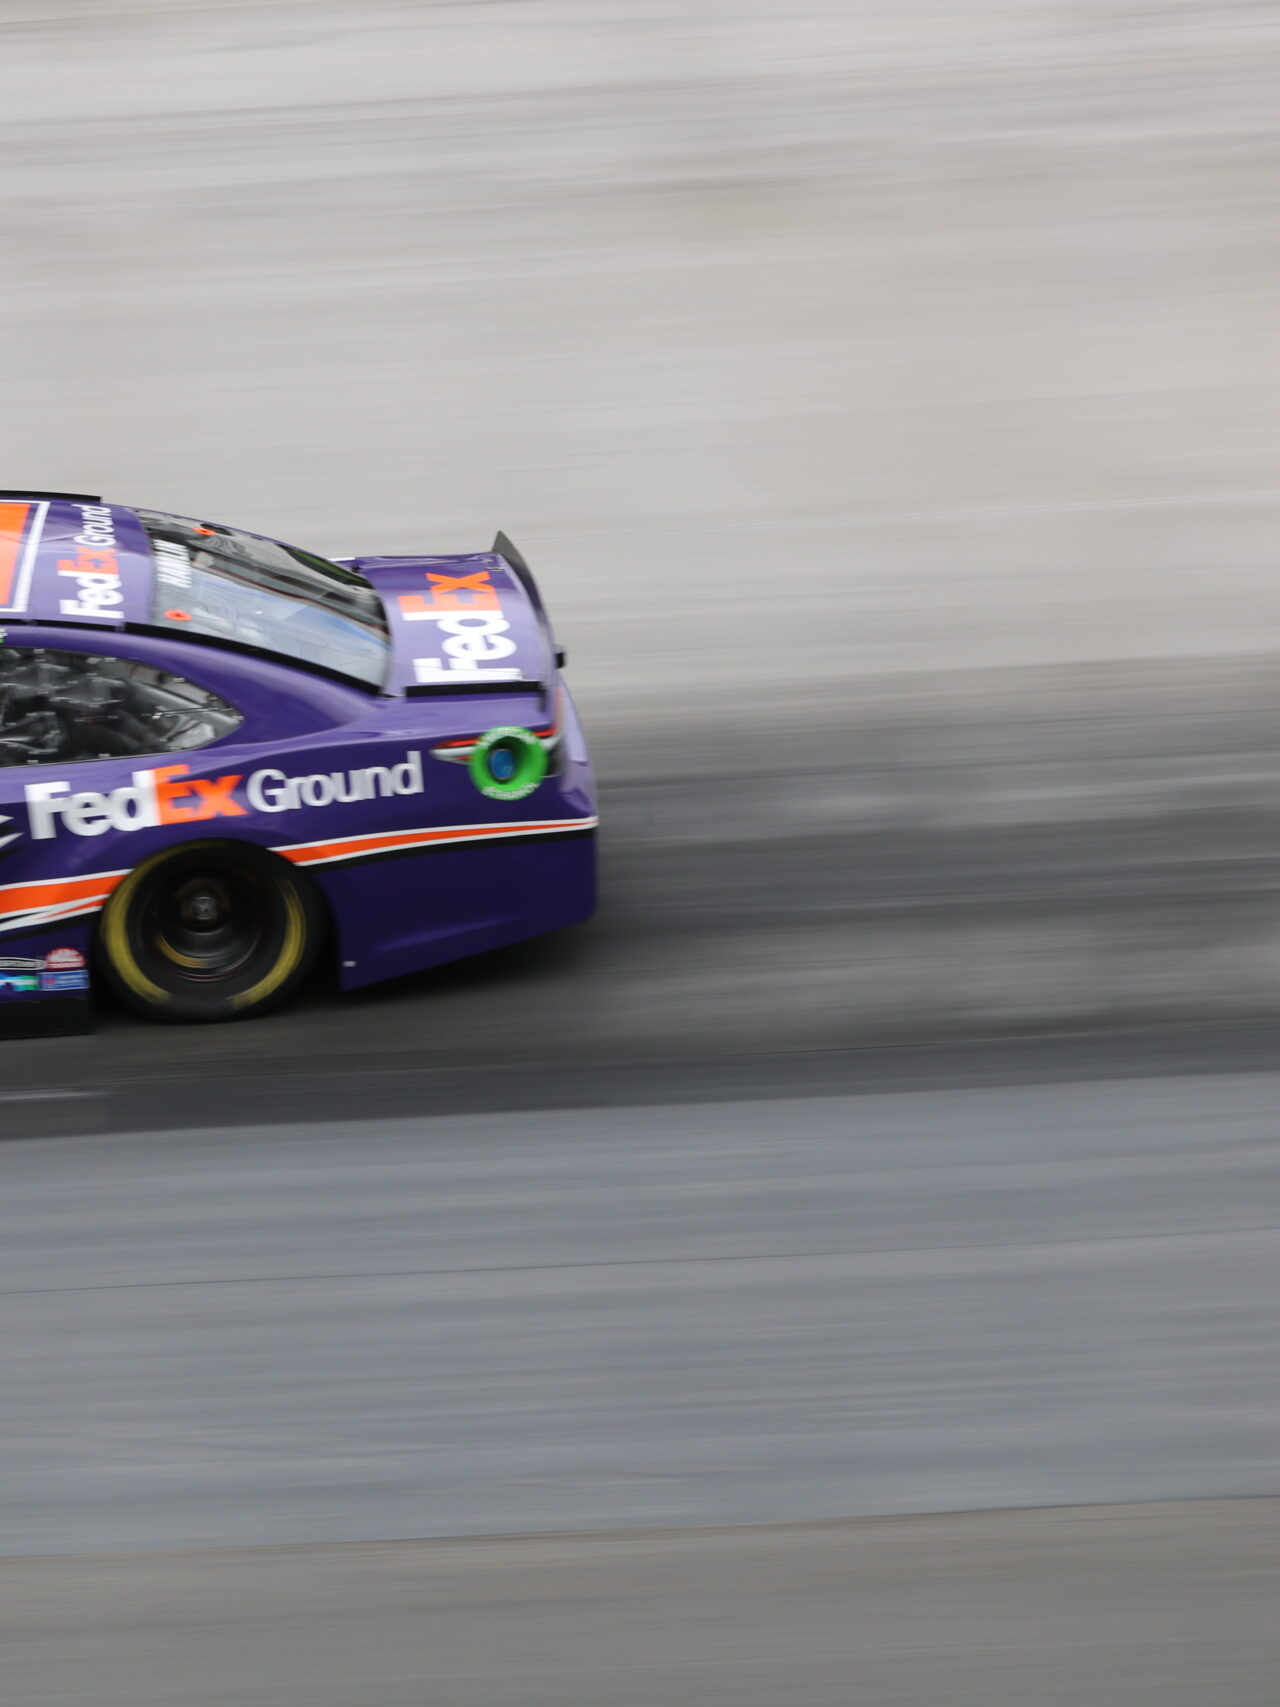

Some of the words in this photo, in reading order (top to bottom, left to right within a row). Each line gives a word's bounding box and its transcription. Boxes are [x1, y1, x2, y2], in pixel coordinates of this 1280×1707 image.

[71, 503, 117, 547] Ground
[57, 546, 124, 619] FedEx
[398, 571, 523, 683] FedEx
[24, 764, 249, 840] FedEx
[247, 751, 425, 813] Ground
